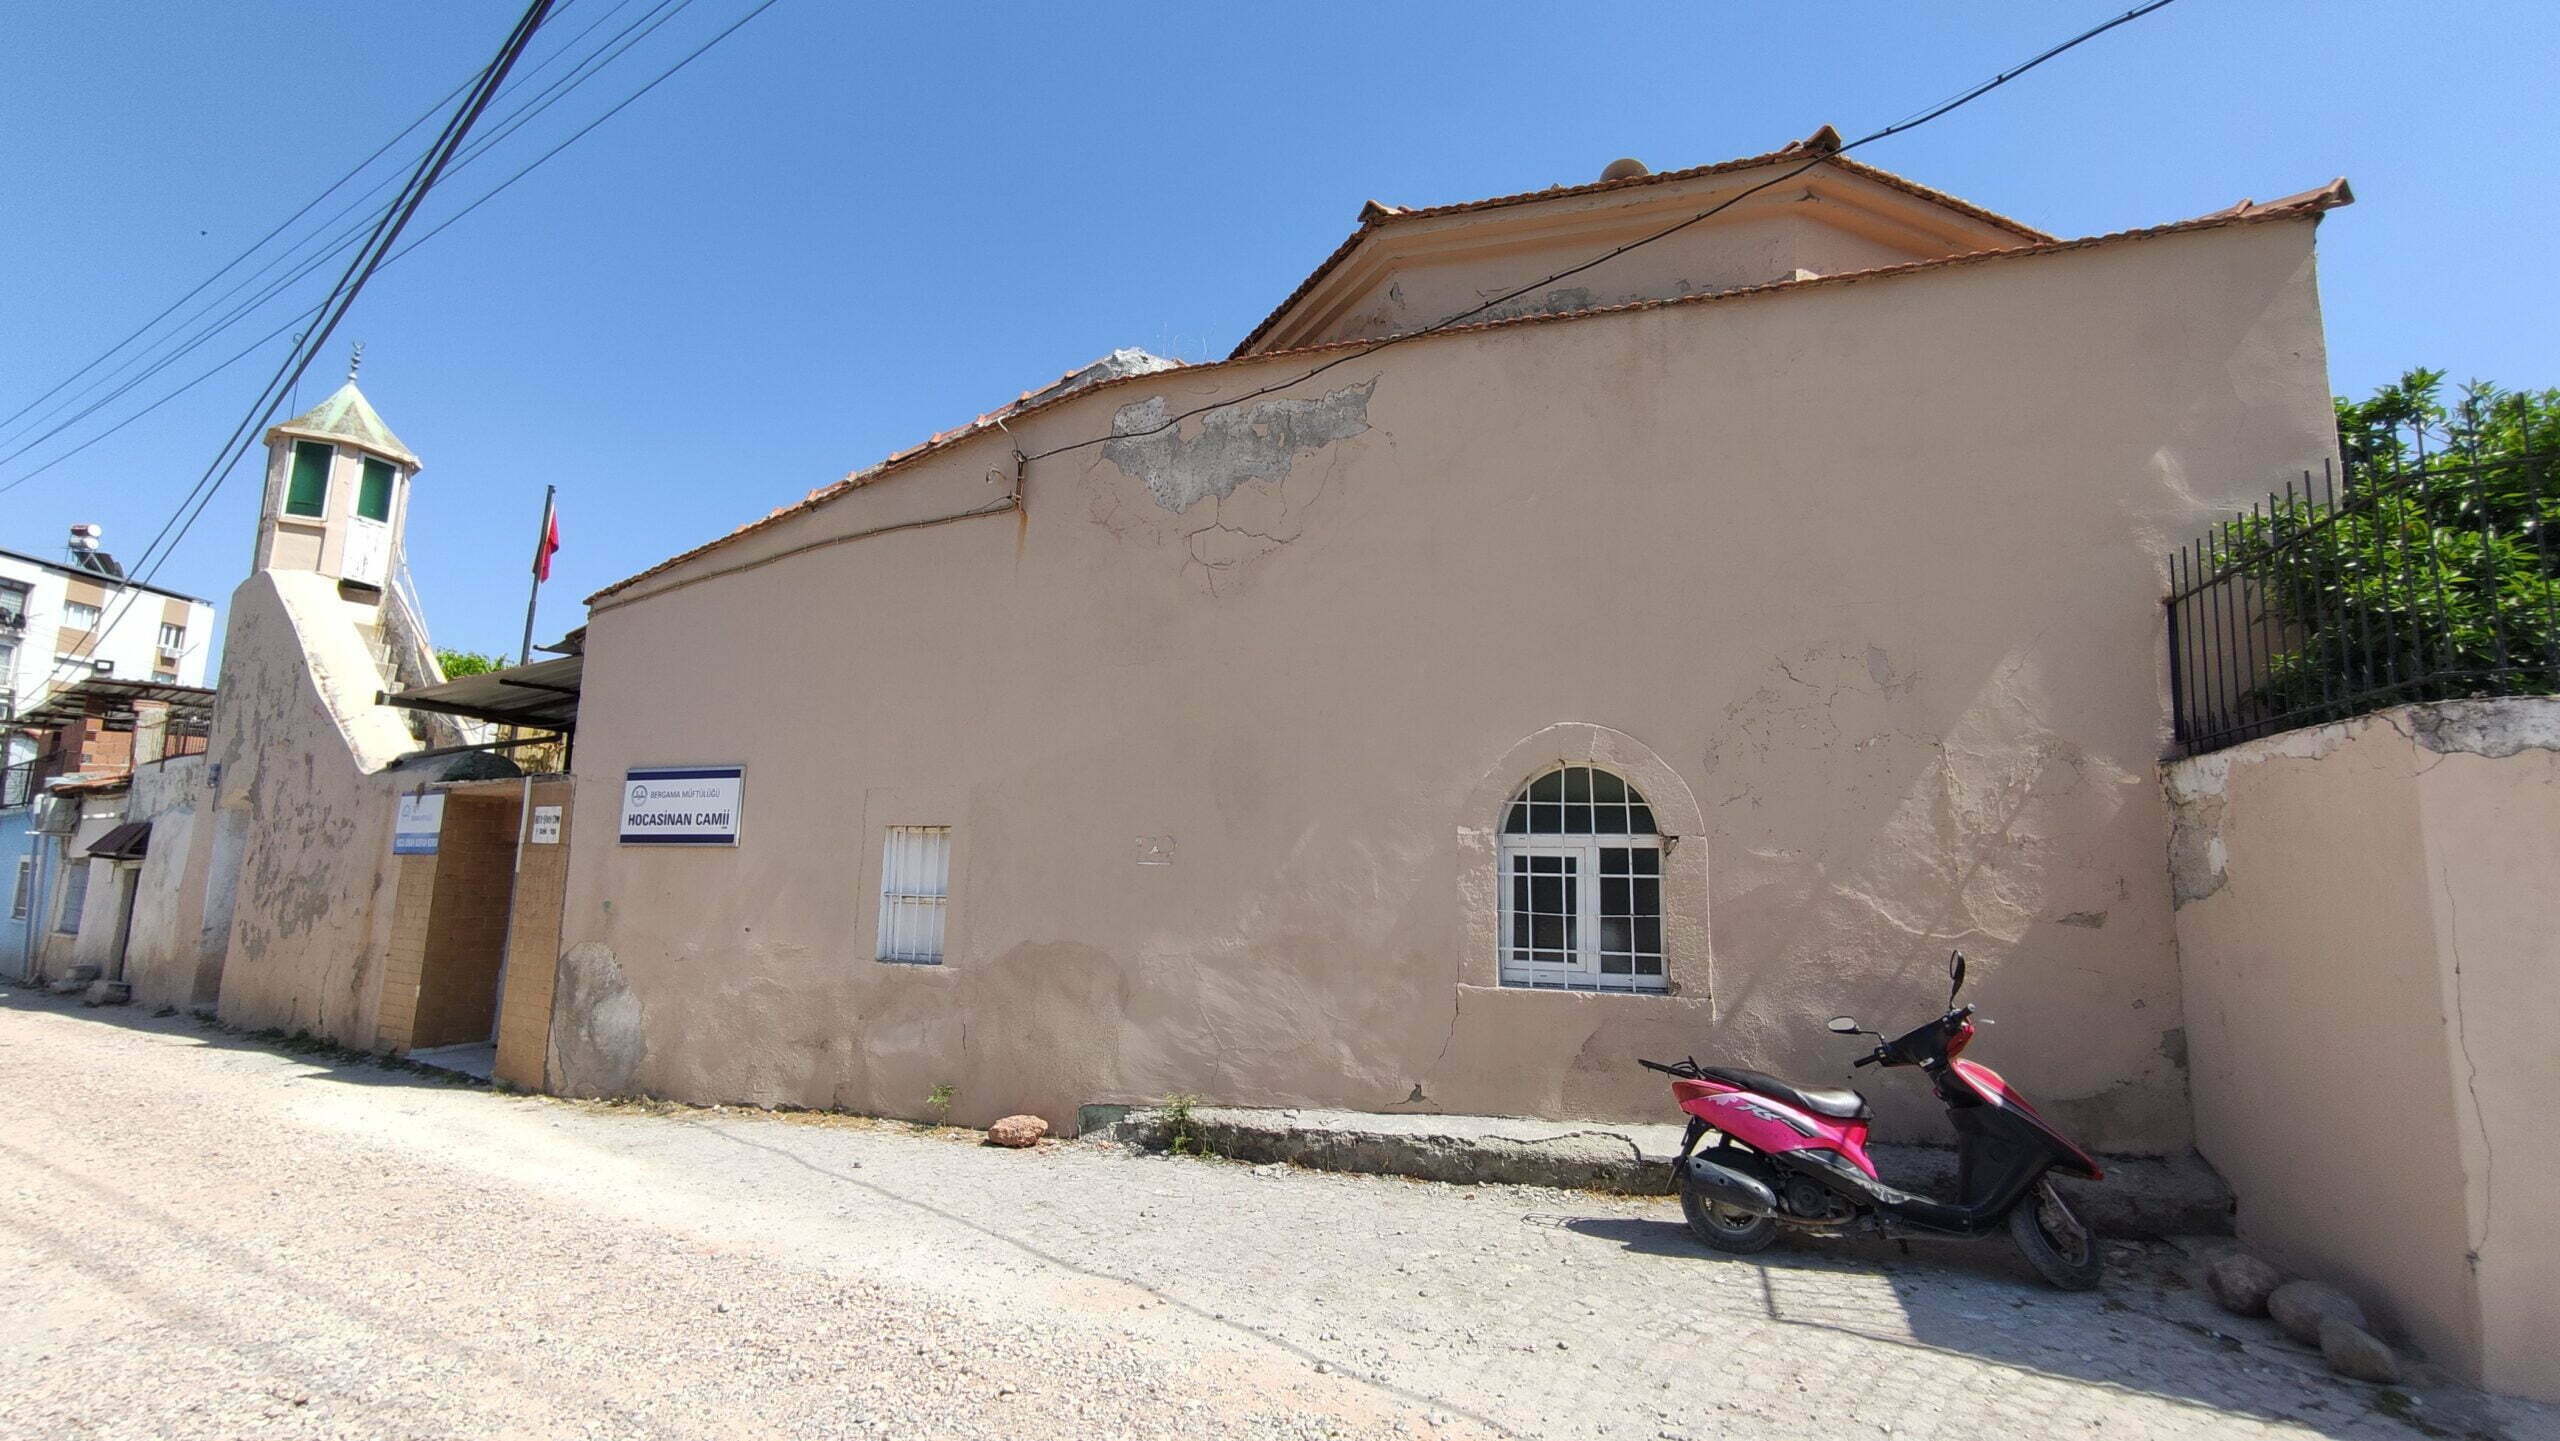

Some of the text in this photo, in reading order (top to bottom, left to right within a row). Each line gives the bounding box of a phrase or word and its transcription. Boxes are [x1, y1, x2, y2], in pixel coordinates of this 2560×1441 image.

[650, 790, 681, 799] BERGAMA
[628, 809, 730, 826] HOCASİNAN CAMİİ
